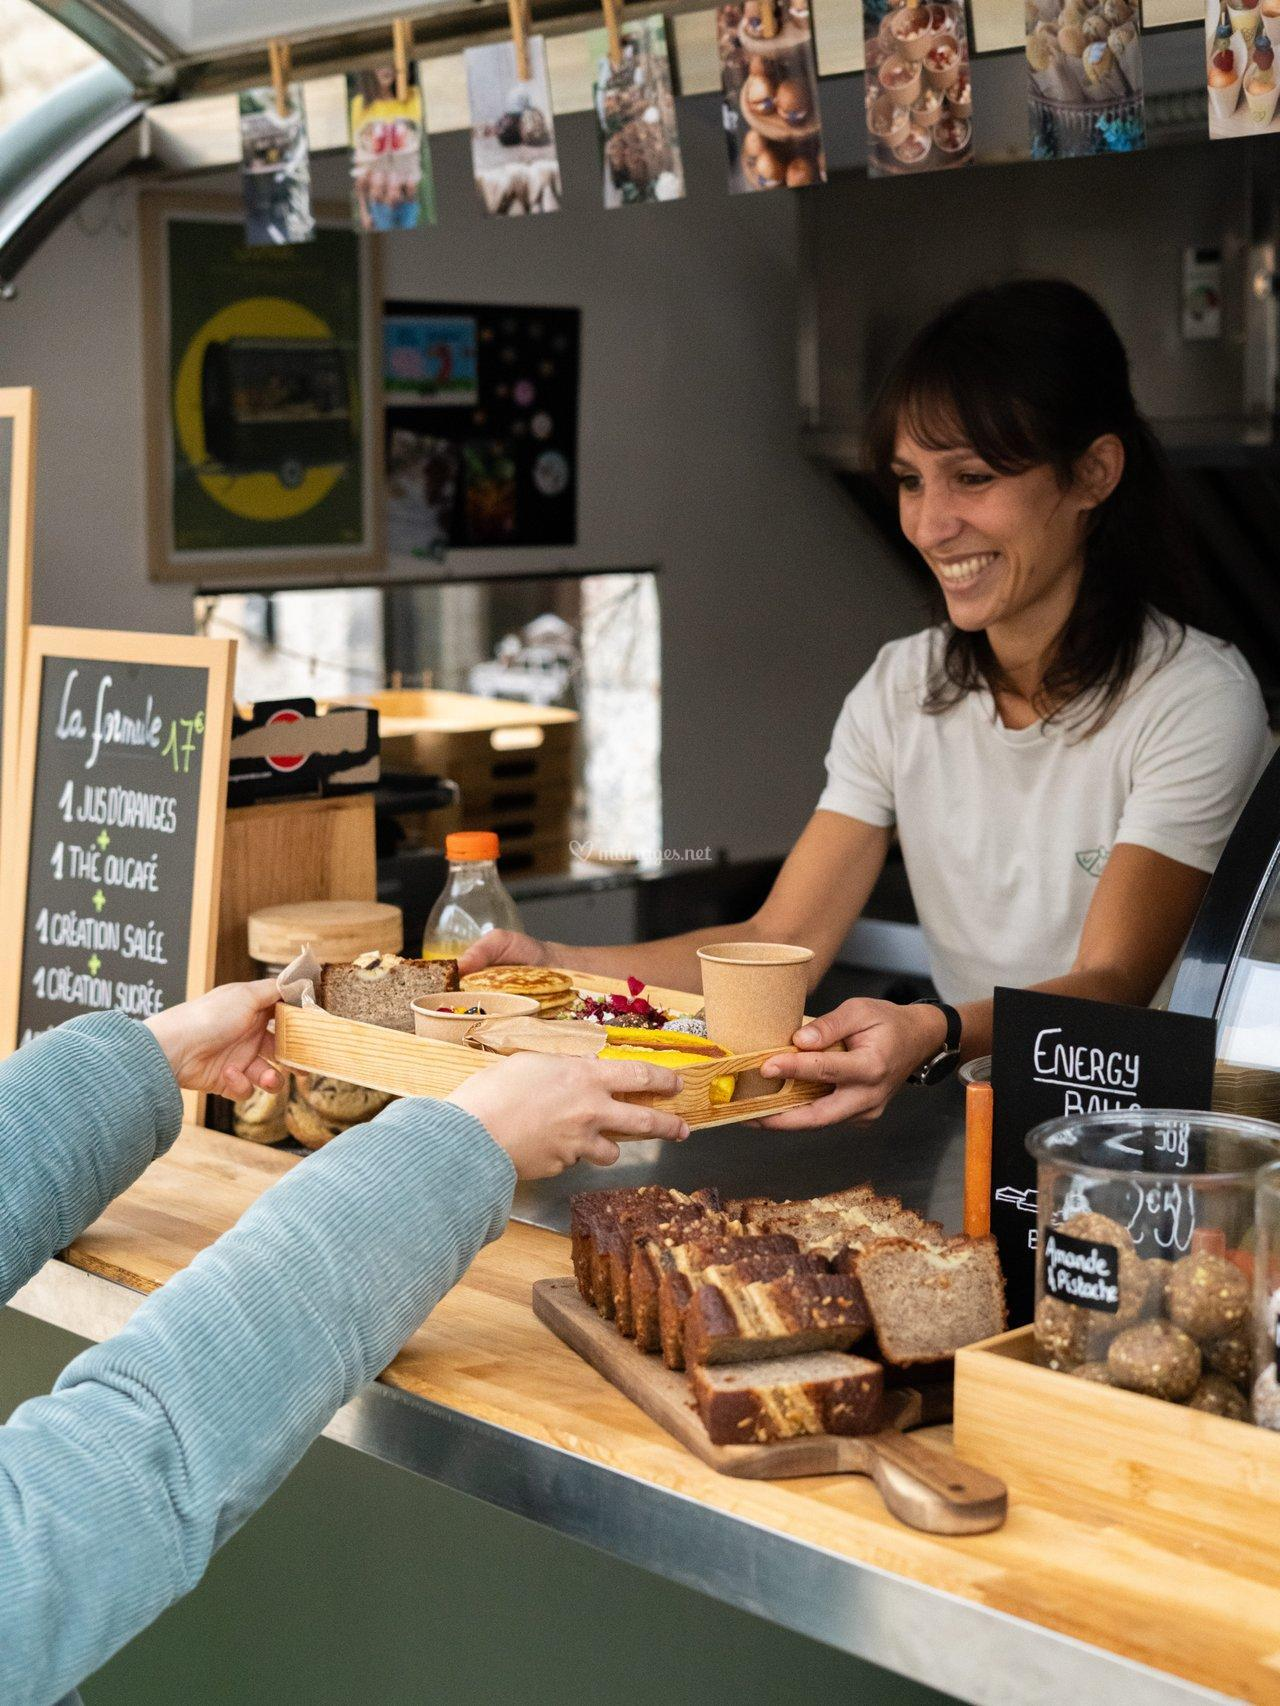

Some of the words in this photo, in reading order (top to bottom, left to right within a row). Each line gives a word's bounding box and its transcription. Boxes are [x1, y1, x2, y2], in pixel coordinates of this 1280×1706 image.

[56, 668, 87, 740] La
[84, 675, 162, 769] formule
[58, 780, 74, 822] 1
[50, 841, 64, 880] 1
[68, 843, 102, 883] THÉ
[35, 907, 49, 944] 1
[50, 909, 120, 951] CRÉATION
[121, 920, 168, 964] SALÉE
[32, 966, 46, 998] 1
[46, 966, 113, 1009] CRÉATION
[114, 979, 164, 1016] SUCRÉE
[1033, 1027, 1140, 1088] ENERGY
[1045, 1235, 1111, 1277] Amande
[1057, 1268, 1118, 1303] Pistache
